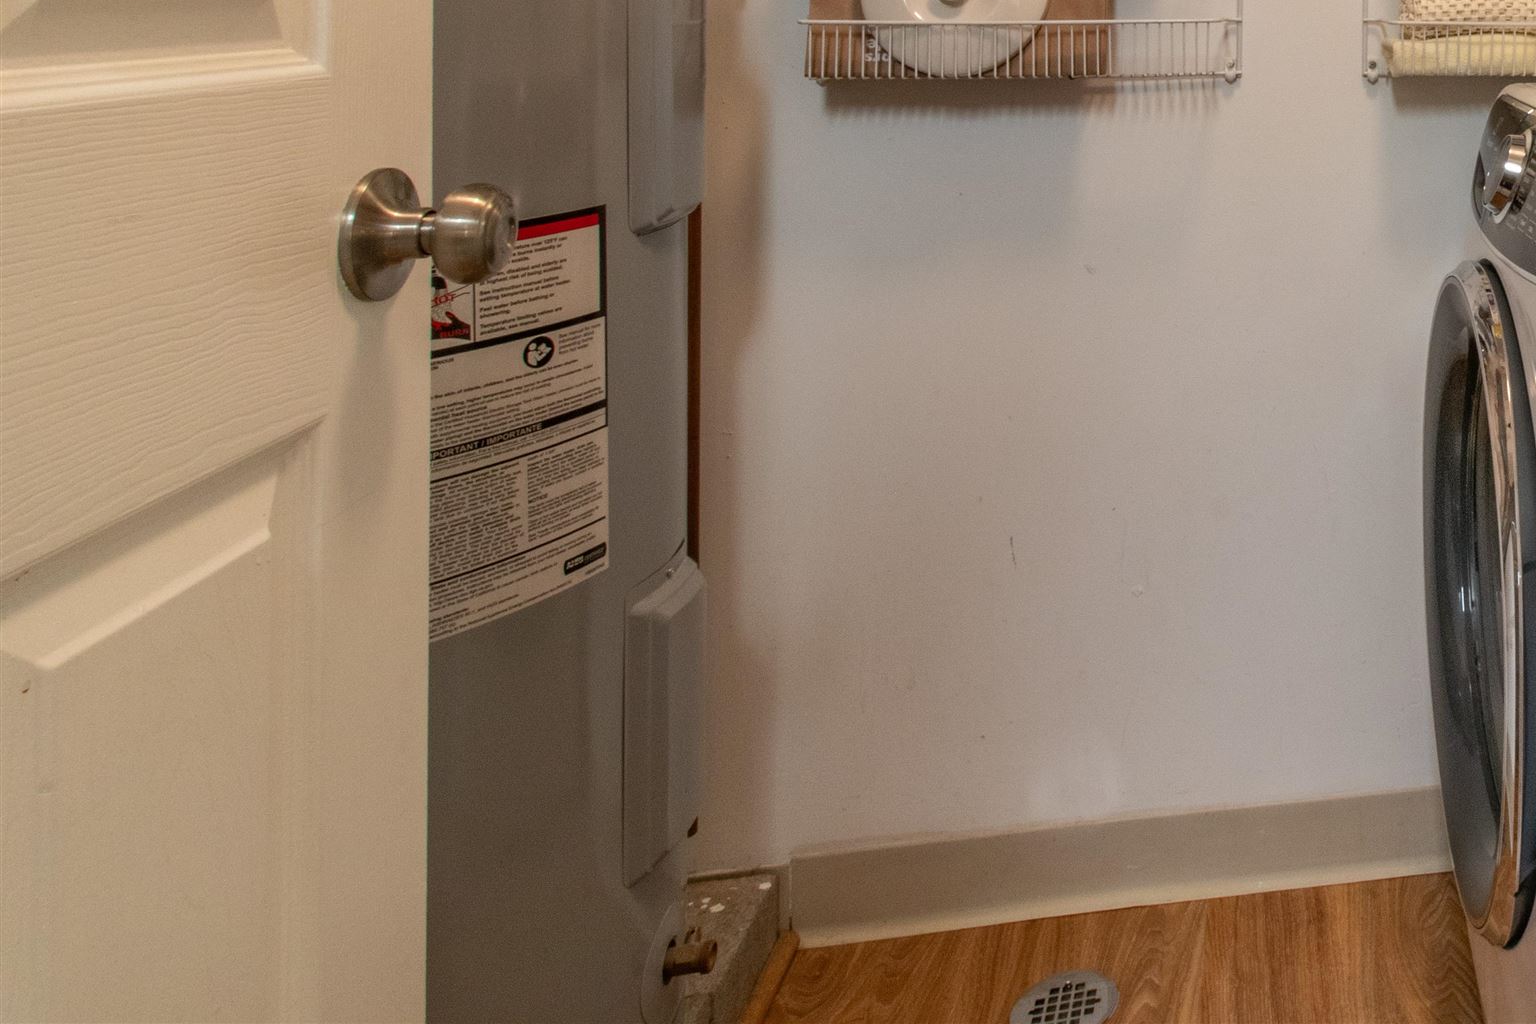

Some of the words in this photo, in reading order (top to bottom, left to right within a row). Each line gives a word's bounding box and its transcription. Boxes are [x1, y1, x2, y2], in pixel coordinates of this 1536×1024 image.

[506, 266, 530, 275] disabled
[541, 260, 558, 268] elderly
[479, 295, 500, 303] setting
[500, 288, 534, 298] temperature
[491, 285, 522, 294] instruction
[510, 299, 528, 307] before
[528, 295, 548, 303] bathing
[479, 318, 516, 329] Temperature
[516, 313, 537, 321] limiting
[485, 422, 543, 447] IMPORTANTE
